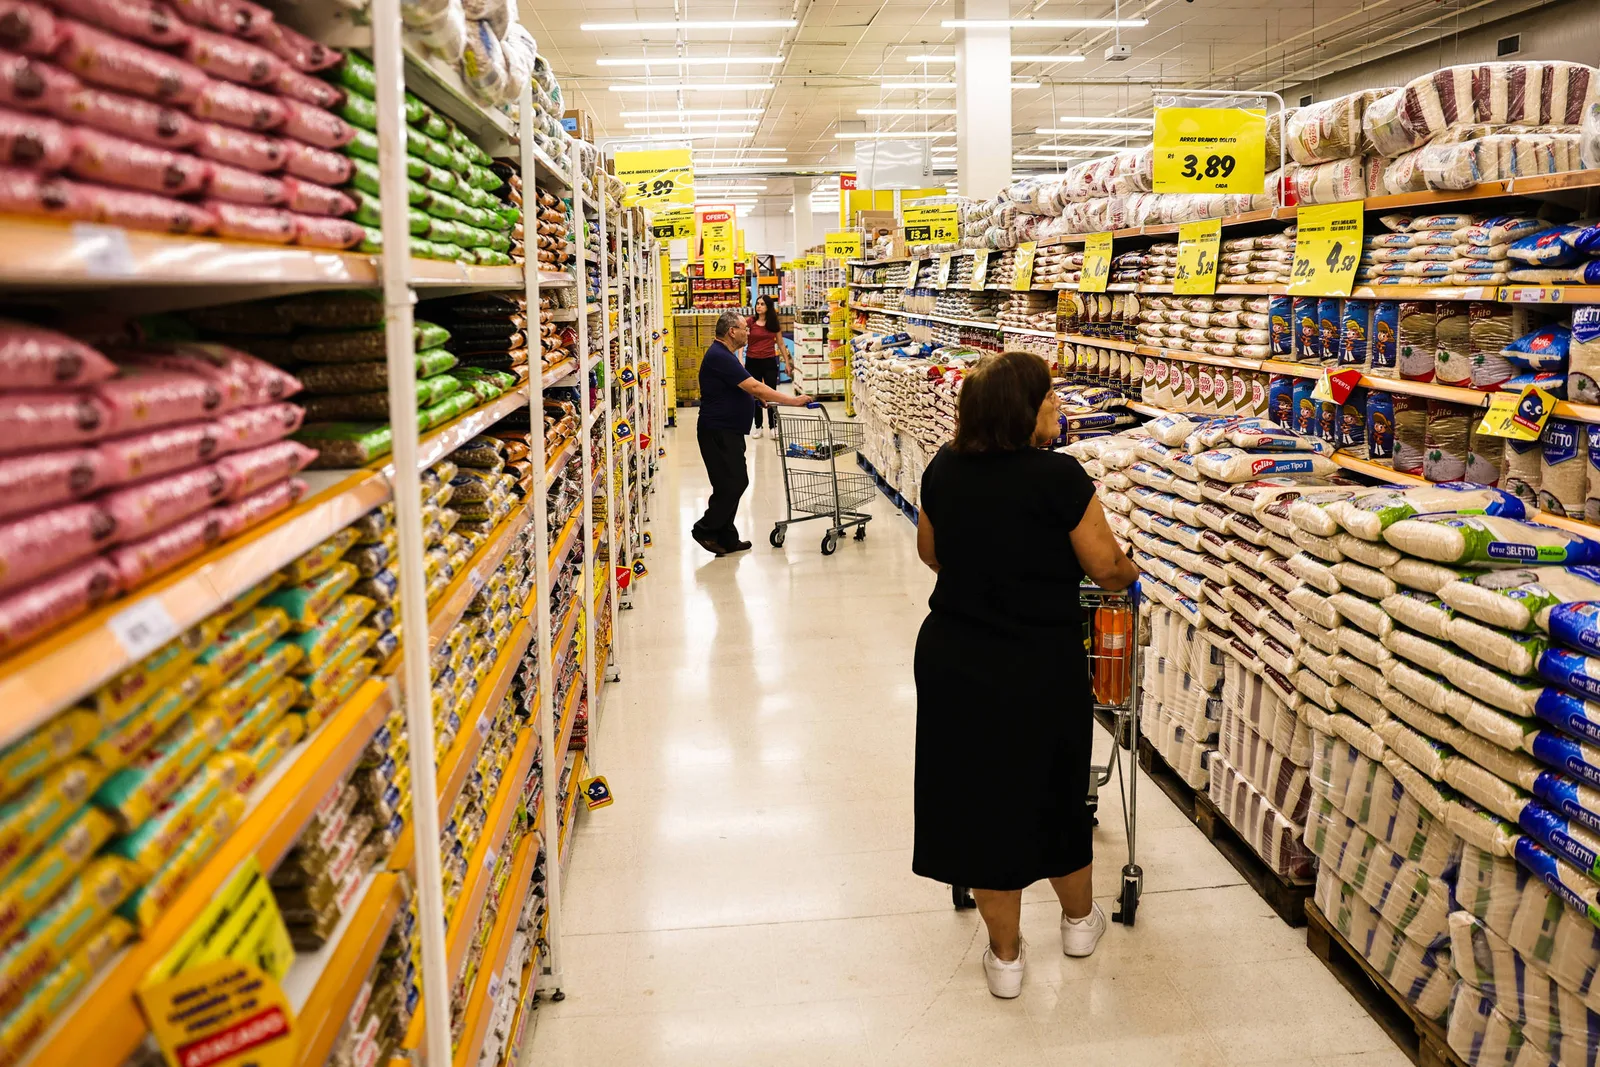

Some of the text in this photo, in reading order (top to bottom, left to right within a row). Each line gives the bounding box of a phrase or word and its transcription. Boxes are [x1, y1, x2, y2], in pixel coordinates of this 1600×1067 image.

[1181, 154, 1236, 181] 3,89
[636, 180, 674, 198] 3,89
[706, 213, 729, 221] OFERTA
[833, 246, 855, 255] 10,79
[1326, 241, 1356, 274] 4,58
[1196, 250, 1215, 276] 5,24
[1294, 259, 1316, 278] 22,89
[1331, 376, 1351, 391] OFERTA
[1514, 415, 1527, 426] MENOR
[1253, 460, 1307, 475] Solito Arroz Tipo 1
[1506, 545, 1536, 557] SELETTO
[1586, 680, 1600, 695] SELE
[1586, 724, 1600, 740] SELE
[1583, 766, 1600, 785] SELET
[1579, 808, 1600, 829] SELETT
[1565, 840, 1594, 866] SELETTO
[1560, 886, 1586, 914] SELETTO
